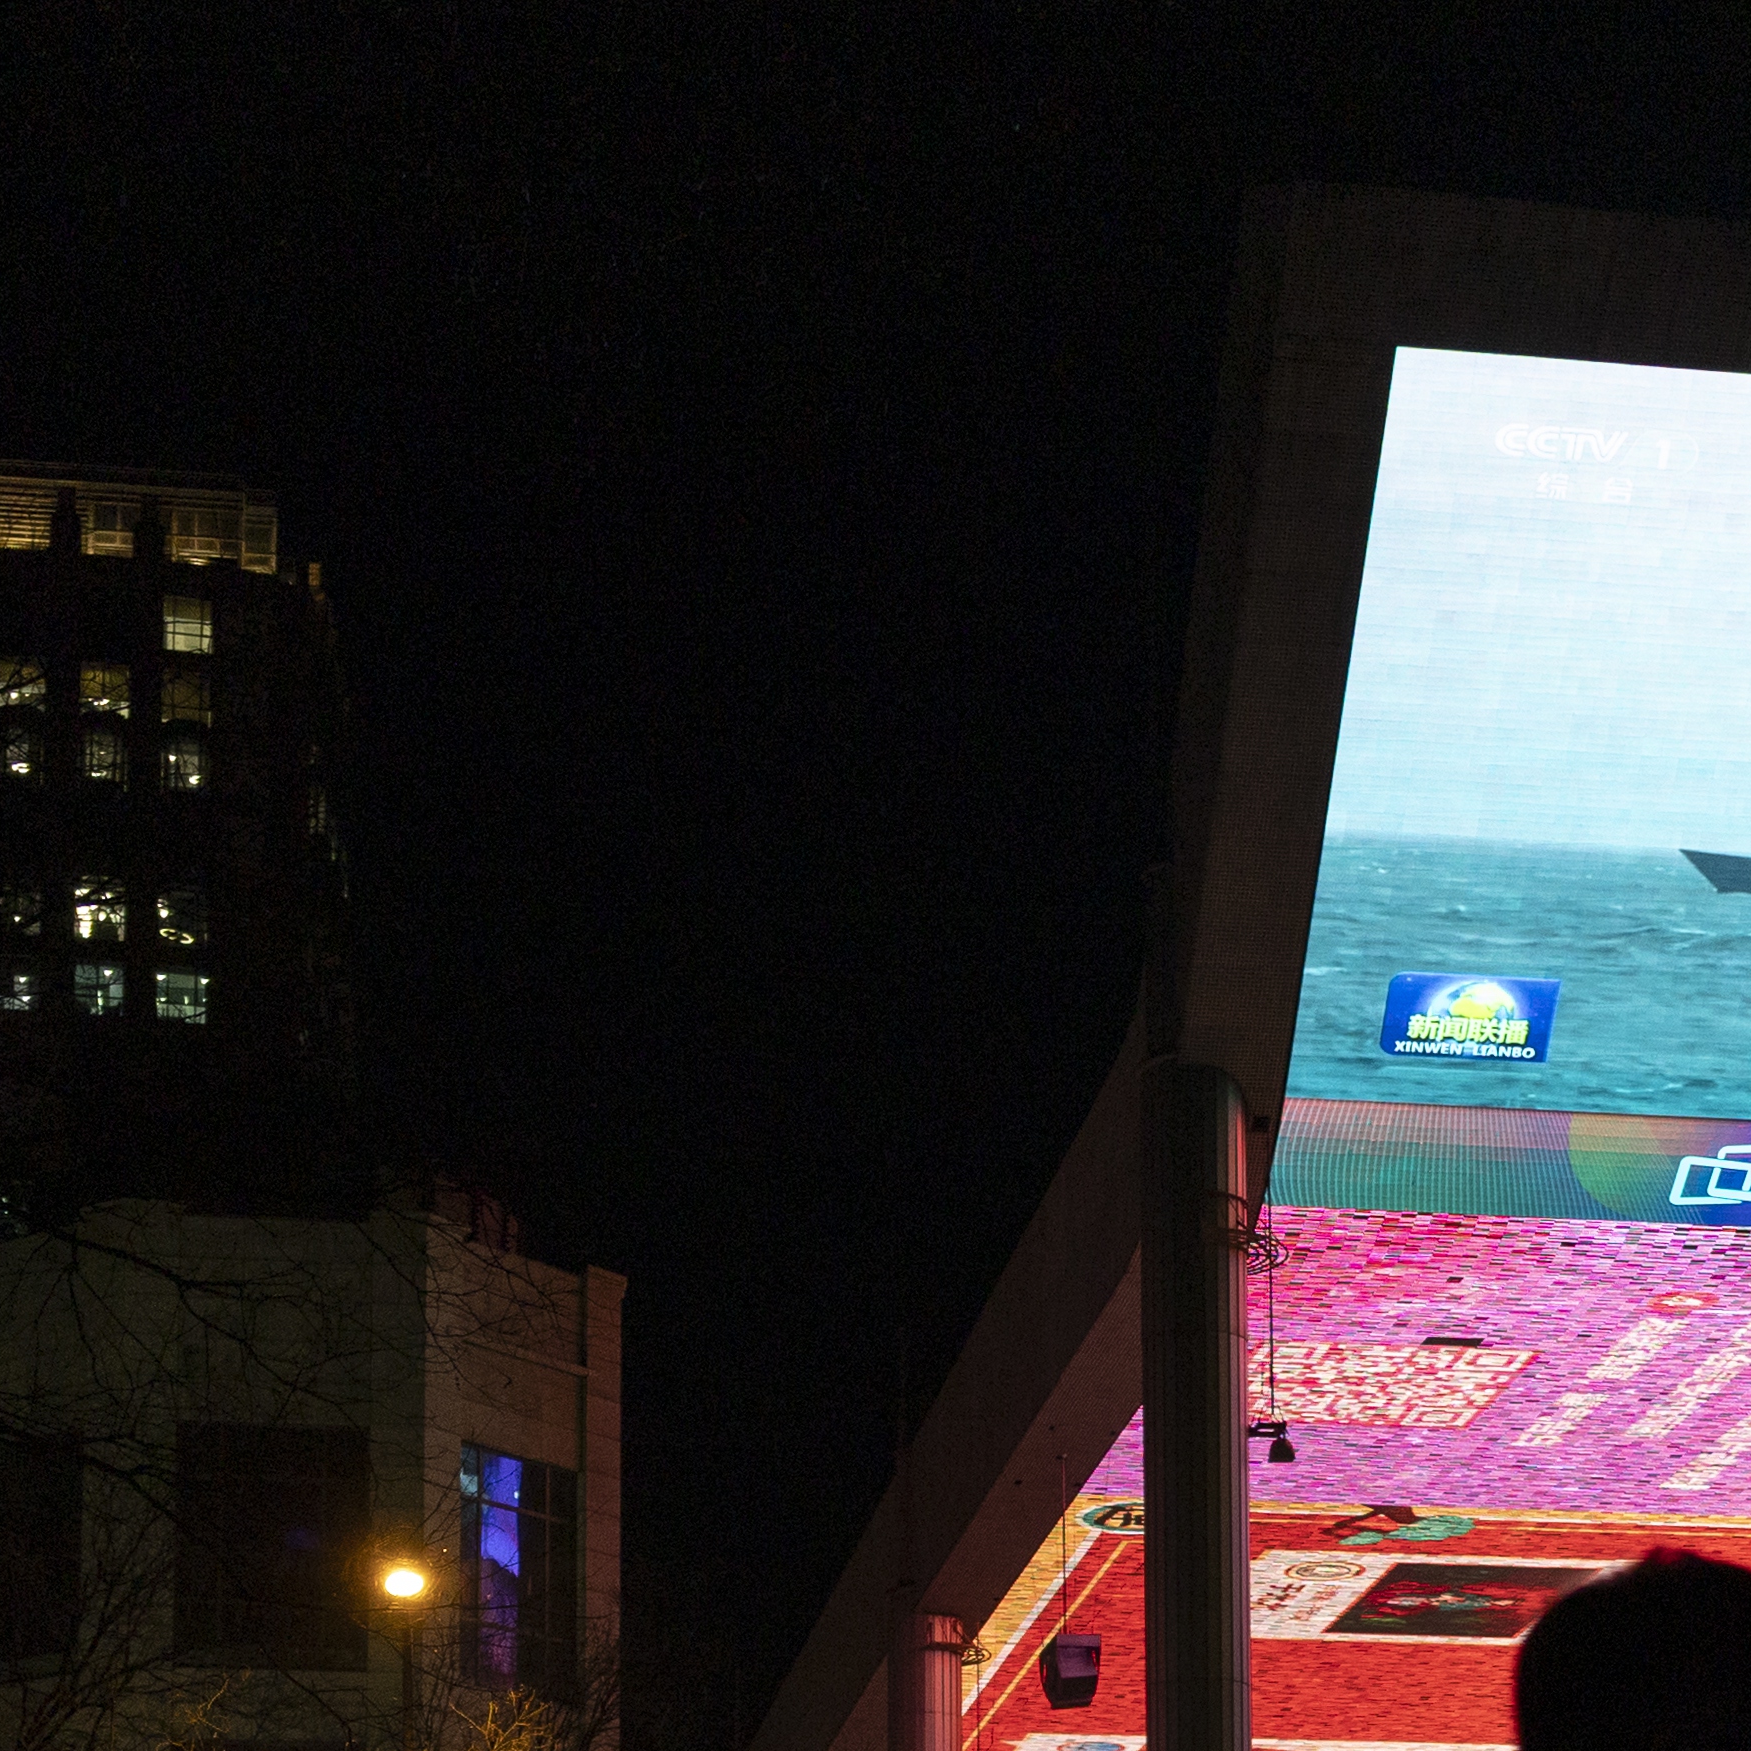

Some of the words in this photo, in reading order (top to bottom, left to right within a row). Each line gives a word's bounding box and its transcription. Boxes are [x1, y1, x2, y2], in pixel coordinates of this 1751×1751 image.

[1494, 422, 1628, 463] CCTV
[1535, 472, 1634, 504] 综合
[1406, 1014, 1530, 1045] 新闻联播
[1393, 1040, 1464, 1057] XINWEN
[1471, 1044, 1537, 1060] LIANBO
